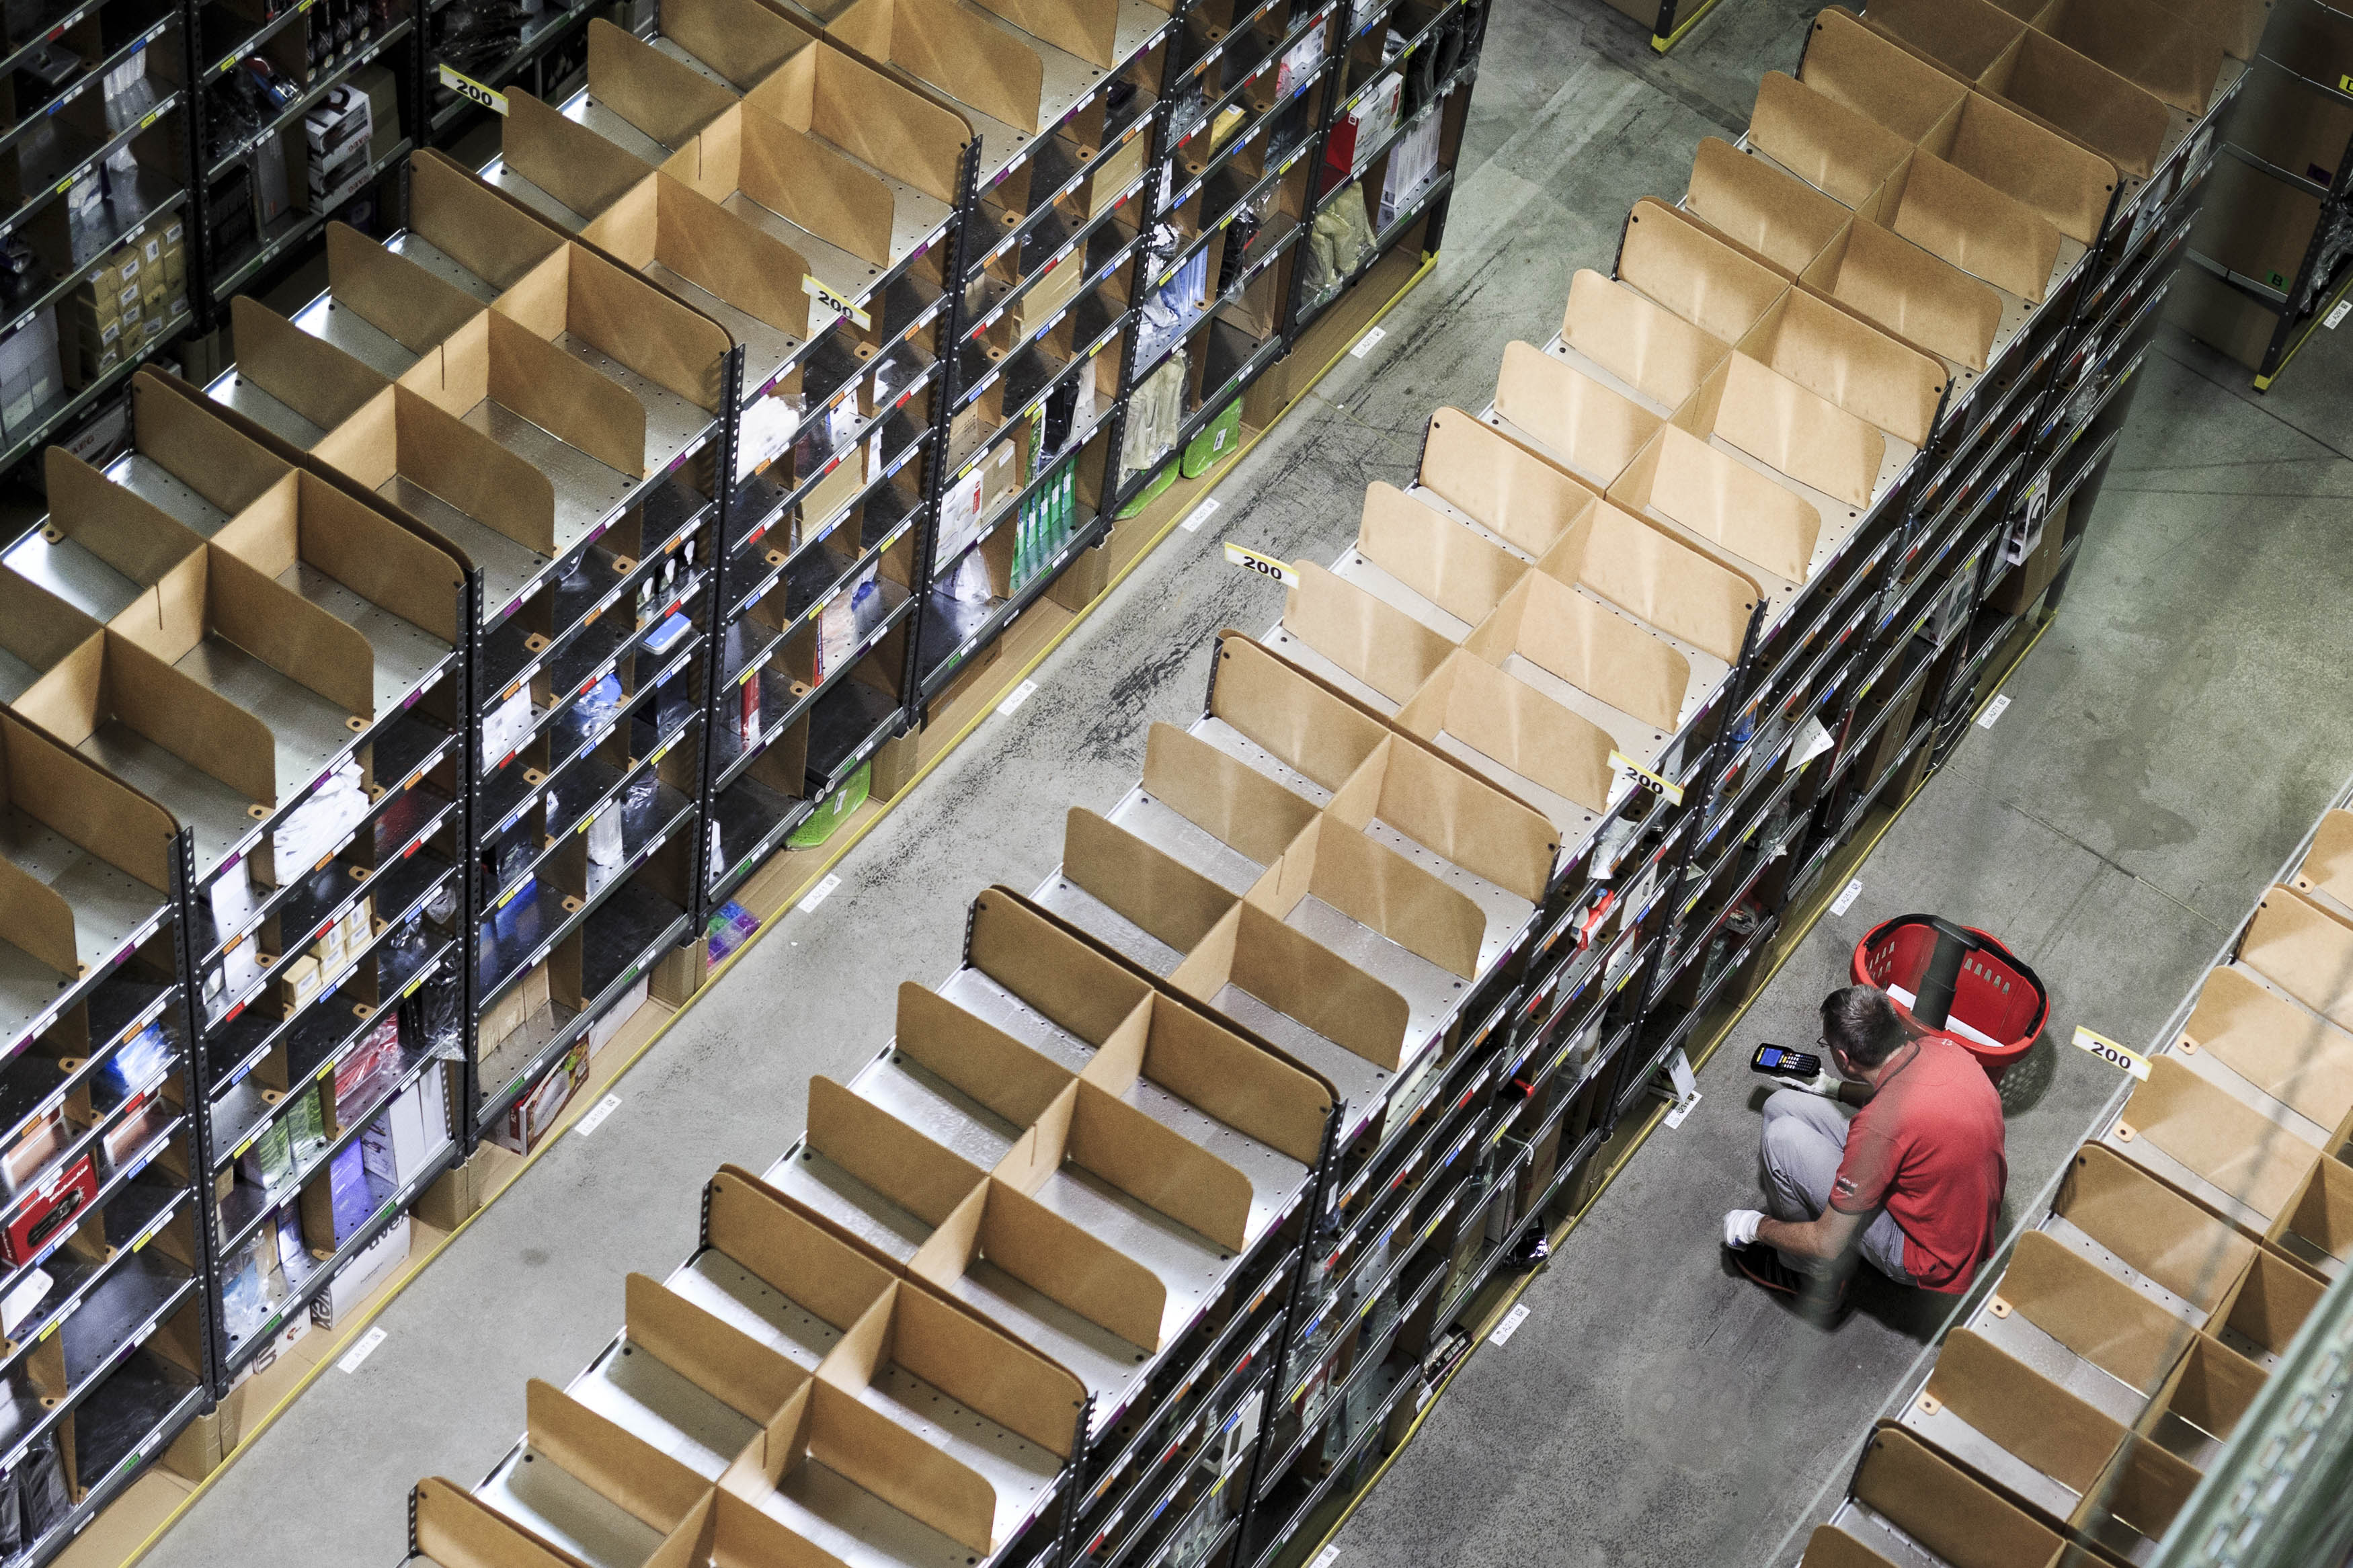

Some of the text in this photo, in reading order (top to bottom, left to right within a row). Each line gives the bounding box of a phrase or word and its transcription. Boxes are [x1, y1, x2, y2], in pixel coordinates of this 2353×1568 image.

[456, 79, 493, 106] 200
[2272, 274, 2282, 286] B
[818, 290, 853, 319] 200
[2331, 308, 2344, 320] A291
[1243, 556, 1281, 580] 200
[1987, 705, 2001, 718] A271
[1626, 766, 1664, 794] 200
[1840, 891, 1854, 904] A251
[2091, 1042, 2130, 1069] 200
[1675, 1102, 1690, 1116] A231
[48, 1165, 88, 1203] KitchenAid
[311, 1286, 331, 1331] vex
[1502, 1317, 1517, 1332] A211
